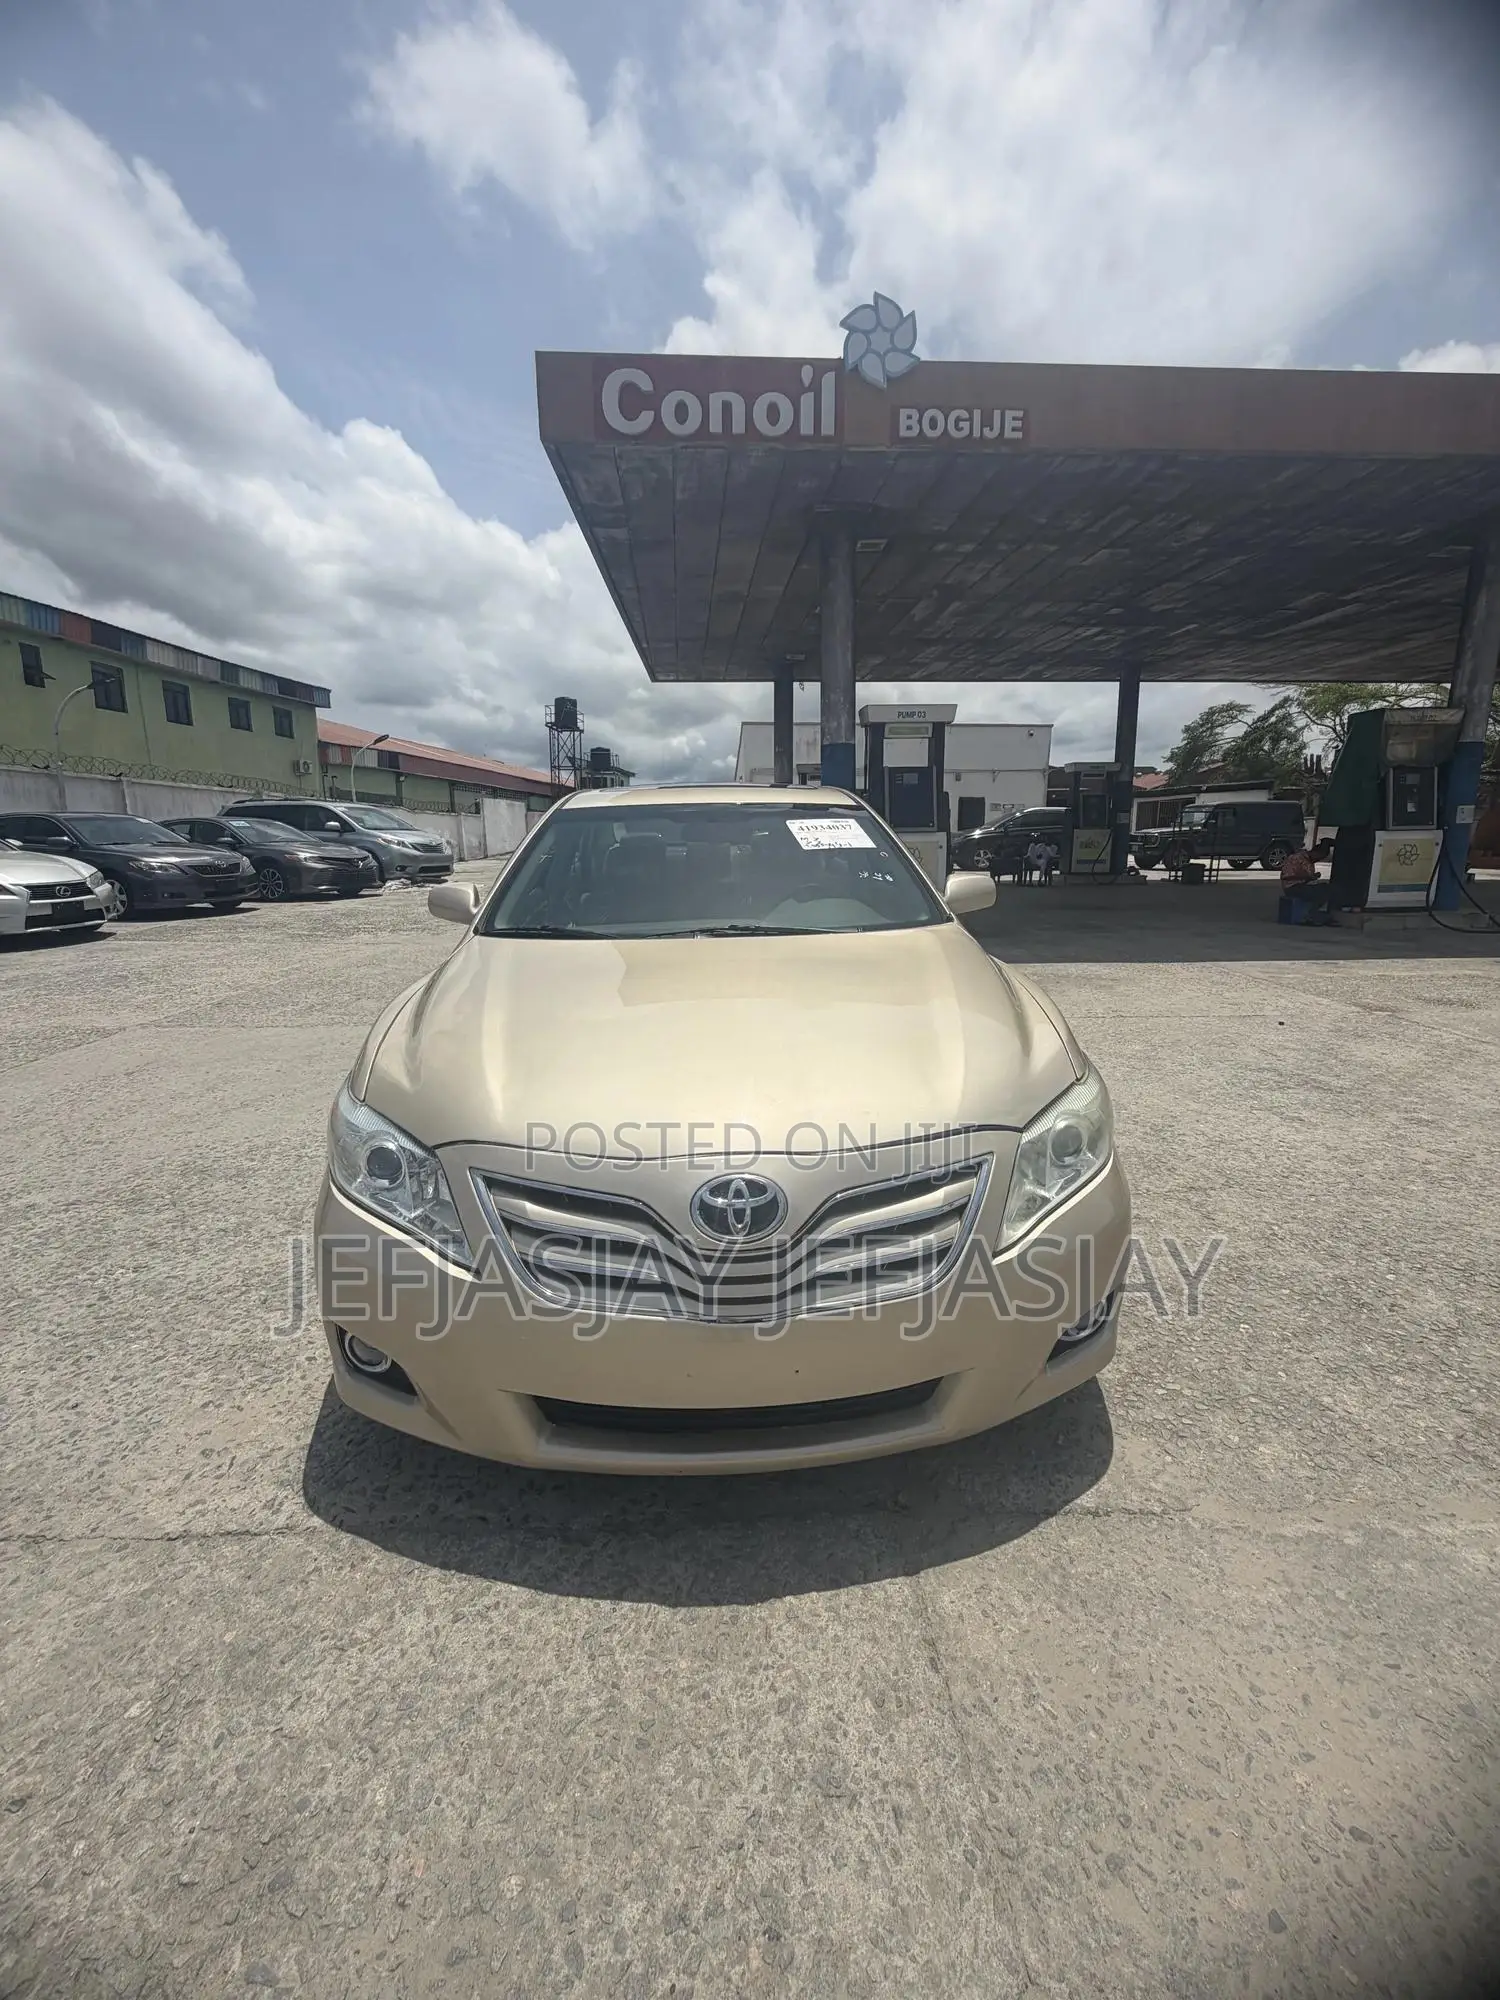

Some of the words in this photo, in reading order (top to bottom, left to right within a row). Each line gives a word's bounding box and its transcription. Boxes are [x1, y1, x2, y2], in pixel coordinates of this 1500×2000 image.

[601, 364, 836, 437] Conoil
[899, 408, 1025, 440] BOGIJE
[897, 711, 917, 719] PUMP
